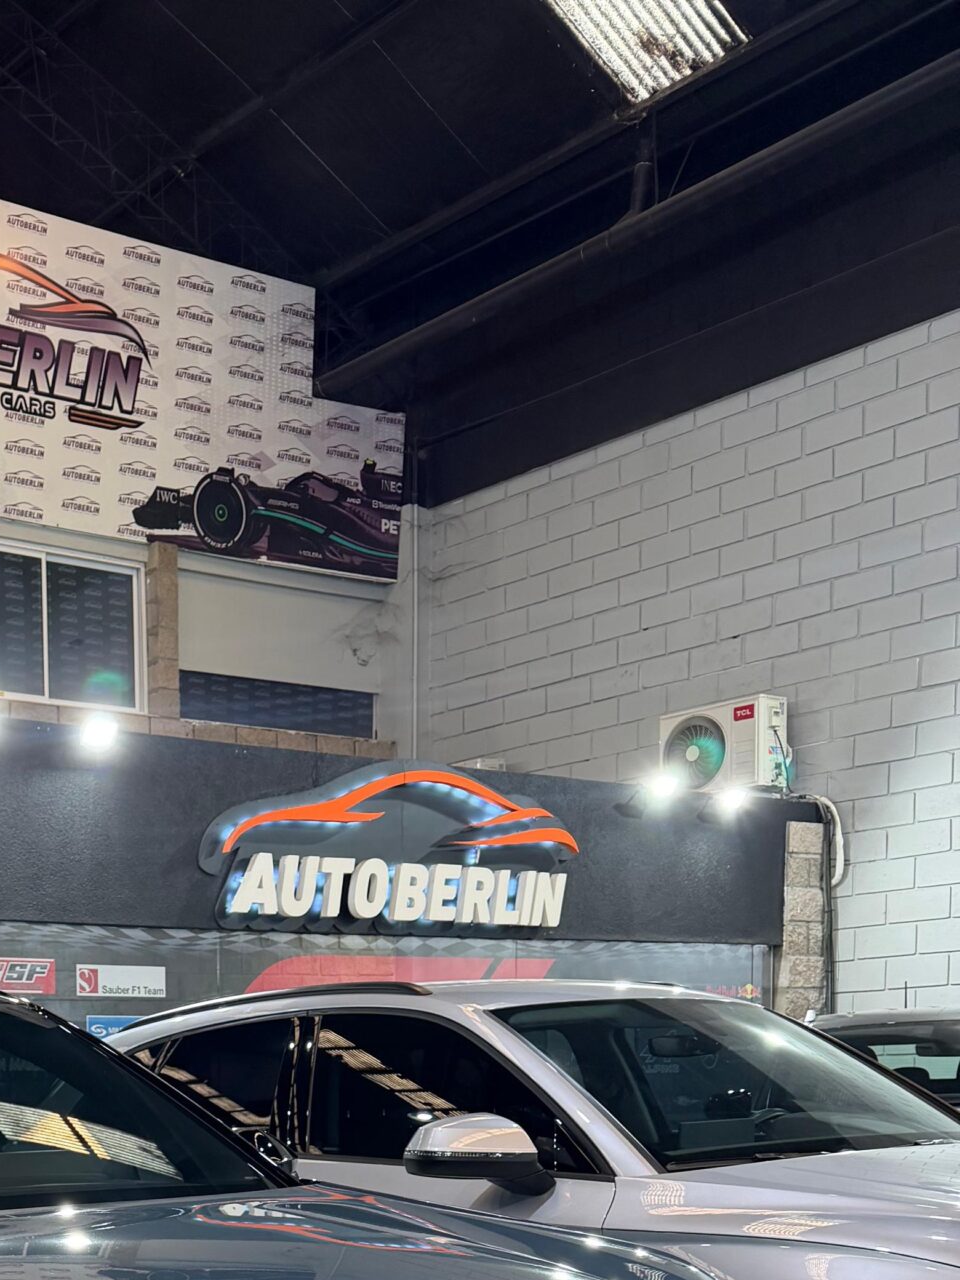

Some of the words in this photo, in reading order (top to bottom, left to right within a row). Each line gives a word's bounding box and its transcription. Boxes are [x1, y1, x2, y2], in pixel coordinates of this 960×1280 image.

[7, 216, 47, 235] AUTOBERLIN
[65, 251, 105, 265] AUTOBERLIN
[123, 250, 161, 265] AUTOBERLIN
[65, 282, 104, 297] AUTOBERLIN
[122, 282, 160, 296] AUTOBERLIN
[177, 280, 214, 294] AUTOBERLIN
[122, 313, 160, 327] AUTOBERLIN
[177, 310, 213, 324] AUTOBERLIN
[176, 341, 212, 354] AUTOBERLIN
[175, 371, 212, 384] AUTOBERLIN
[0, 391, 56, 419] CARS
[175, 401, 211, 414] AUTOBERLIN
[120, 436, 157, 448] AUTOBERLIN
[174, 431, 210, 444] AUTOBERLIN
[5, 443, 44, 458] AUTOBERLIN
[63, 439, 101, 452] AUTOBERLIN
[119, 466, 156, 479] AUTOBERLIN
[173, 461, 209, 473] AUTOBERLIN
[4, 475, 44, 489] AUTOBERLIN
[62, 471, 100, 483] AUTOBERLIN
[156, 490, 178, 504] IWC
[4, 507, 43, 520] AUTOBERLIN
[61, 502, 100, 514] AUTOBERLIN
[735, 709, 752, 717] TCL
[229, 852, 567, 927] AUTOBERLIN
[3, 962, 50, 983] SF
[102, 985, 130, 994] Sauber
[131, 986, 141, 994] F1
[144, 986, 164, 995] Team
